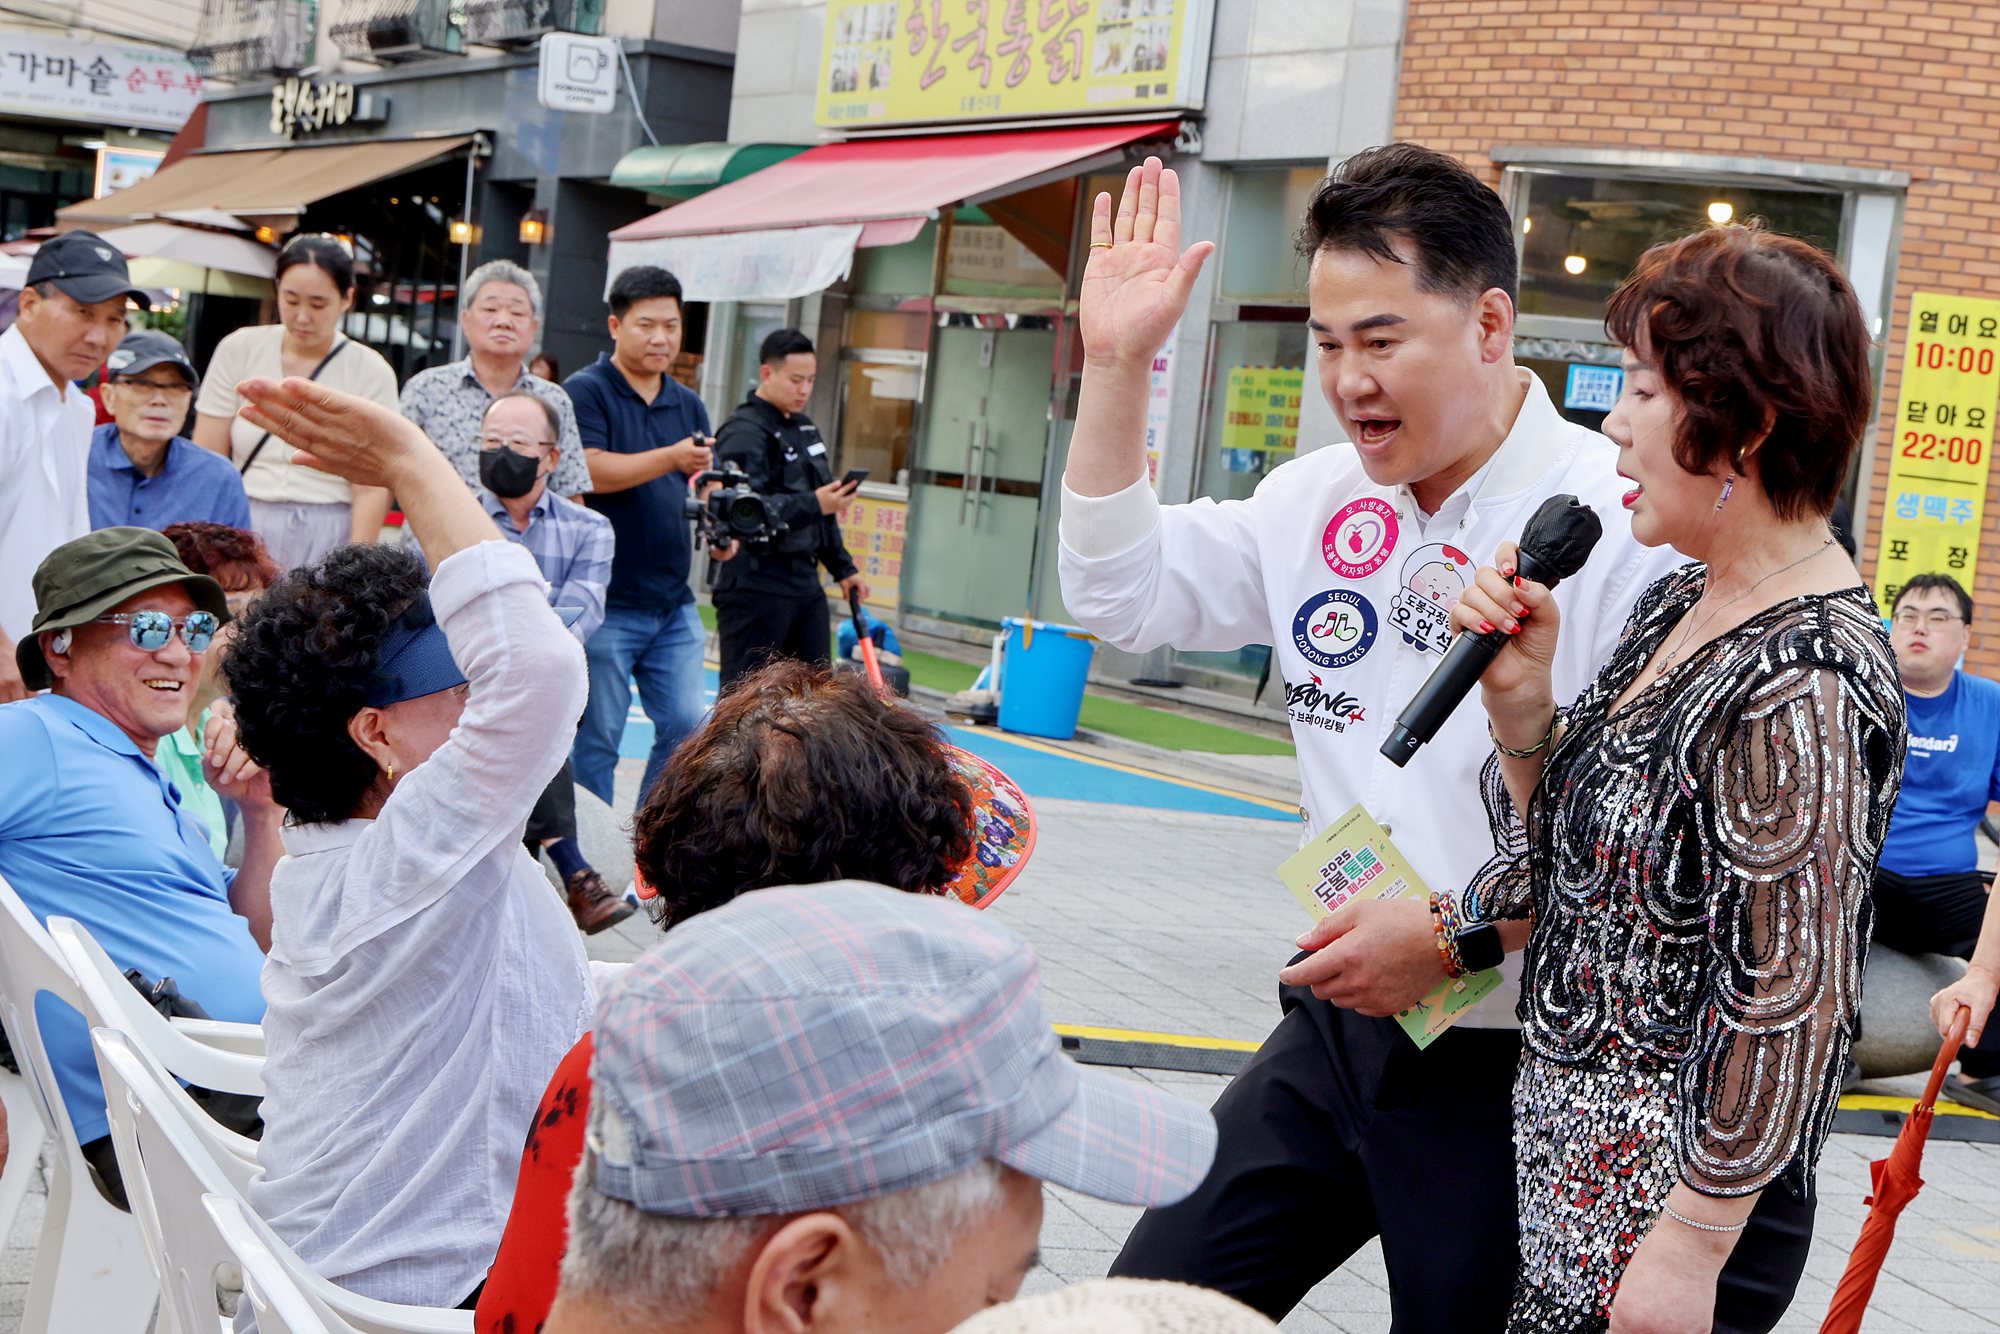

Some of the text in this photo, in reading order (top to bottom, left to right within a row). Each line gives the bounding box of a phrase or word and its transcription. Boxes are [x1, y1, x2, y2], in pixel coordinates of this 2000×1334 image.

[905, 0, 1090, 91] 한국통닭
[8, 52, 119, 97] 가마솥
[1920, 311, 1998, 338] 열어요
[1916, 342, 1994, 375] 10:00
[1907, 401, 1986, 429] 닫아요
[1902, 431, 1982, 465] 22:00
[1895, 492, 1974, 525] 생맥주
[1327, 592, 1361, 607] SEOUL
[1295, 633, 1366, 666] DOBONG SOCKS
[1296, 711, 1346, 734] 브레이킹팀
[1406, 737, 1418, 748] 2
[1320, 849, 1352, 878] 2025
[1326, 893, 1348, 912] 예술
[1346, 861, 1385, 896] 페스티벌
